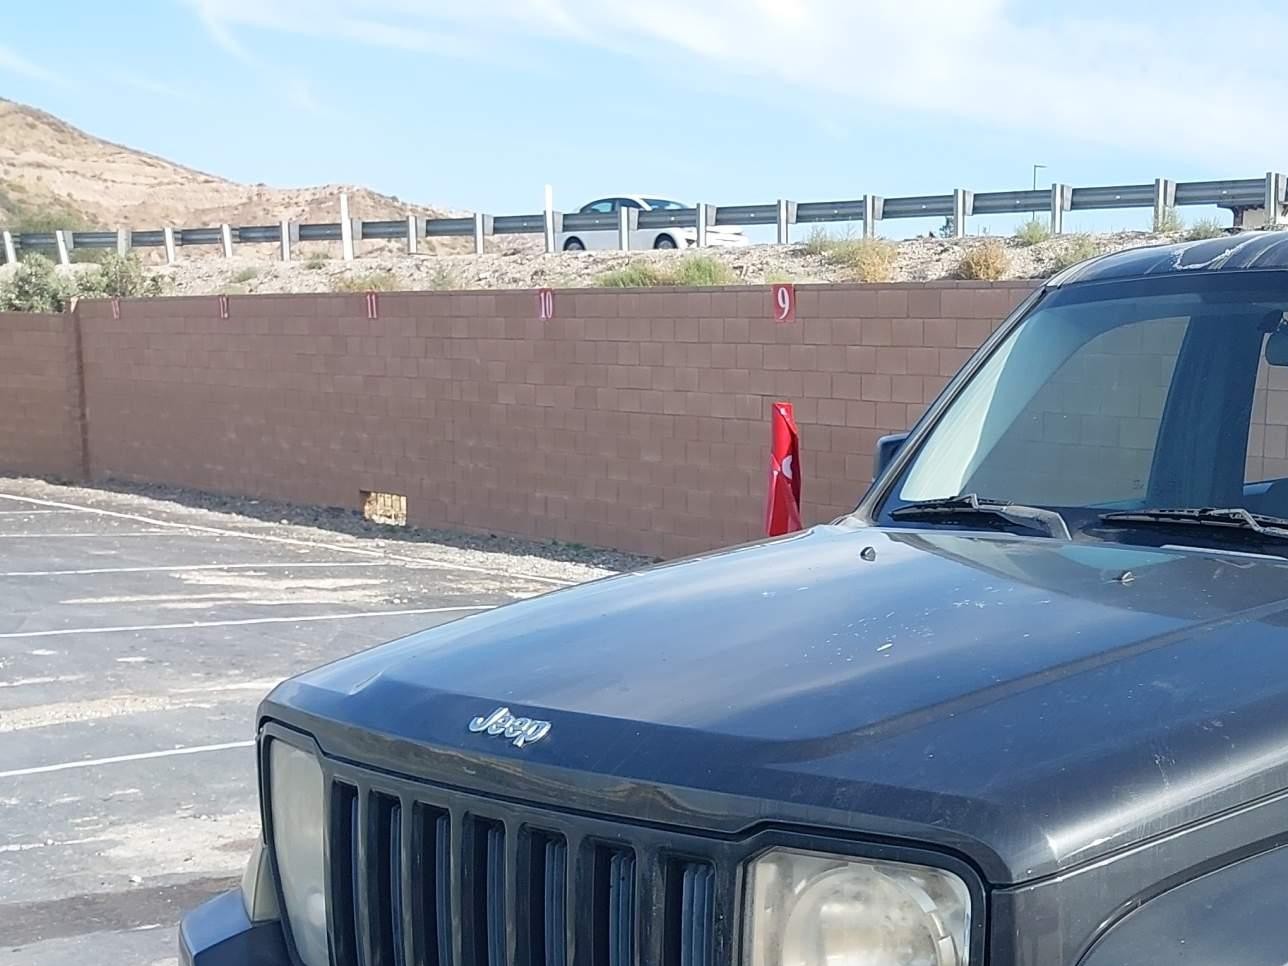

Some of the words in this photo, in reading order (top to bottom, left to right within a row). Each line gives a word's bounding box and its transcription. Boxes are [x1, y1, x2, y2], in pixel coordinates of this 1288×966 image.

[540, 290, 553, 320] 10
[776, 287, 790, 320] 9
[468, 706, 552, 748] Jeep
